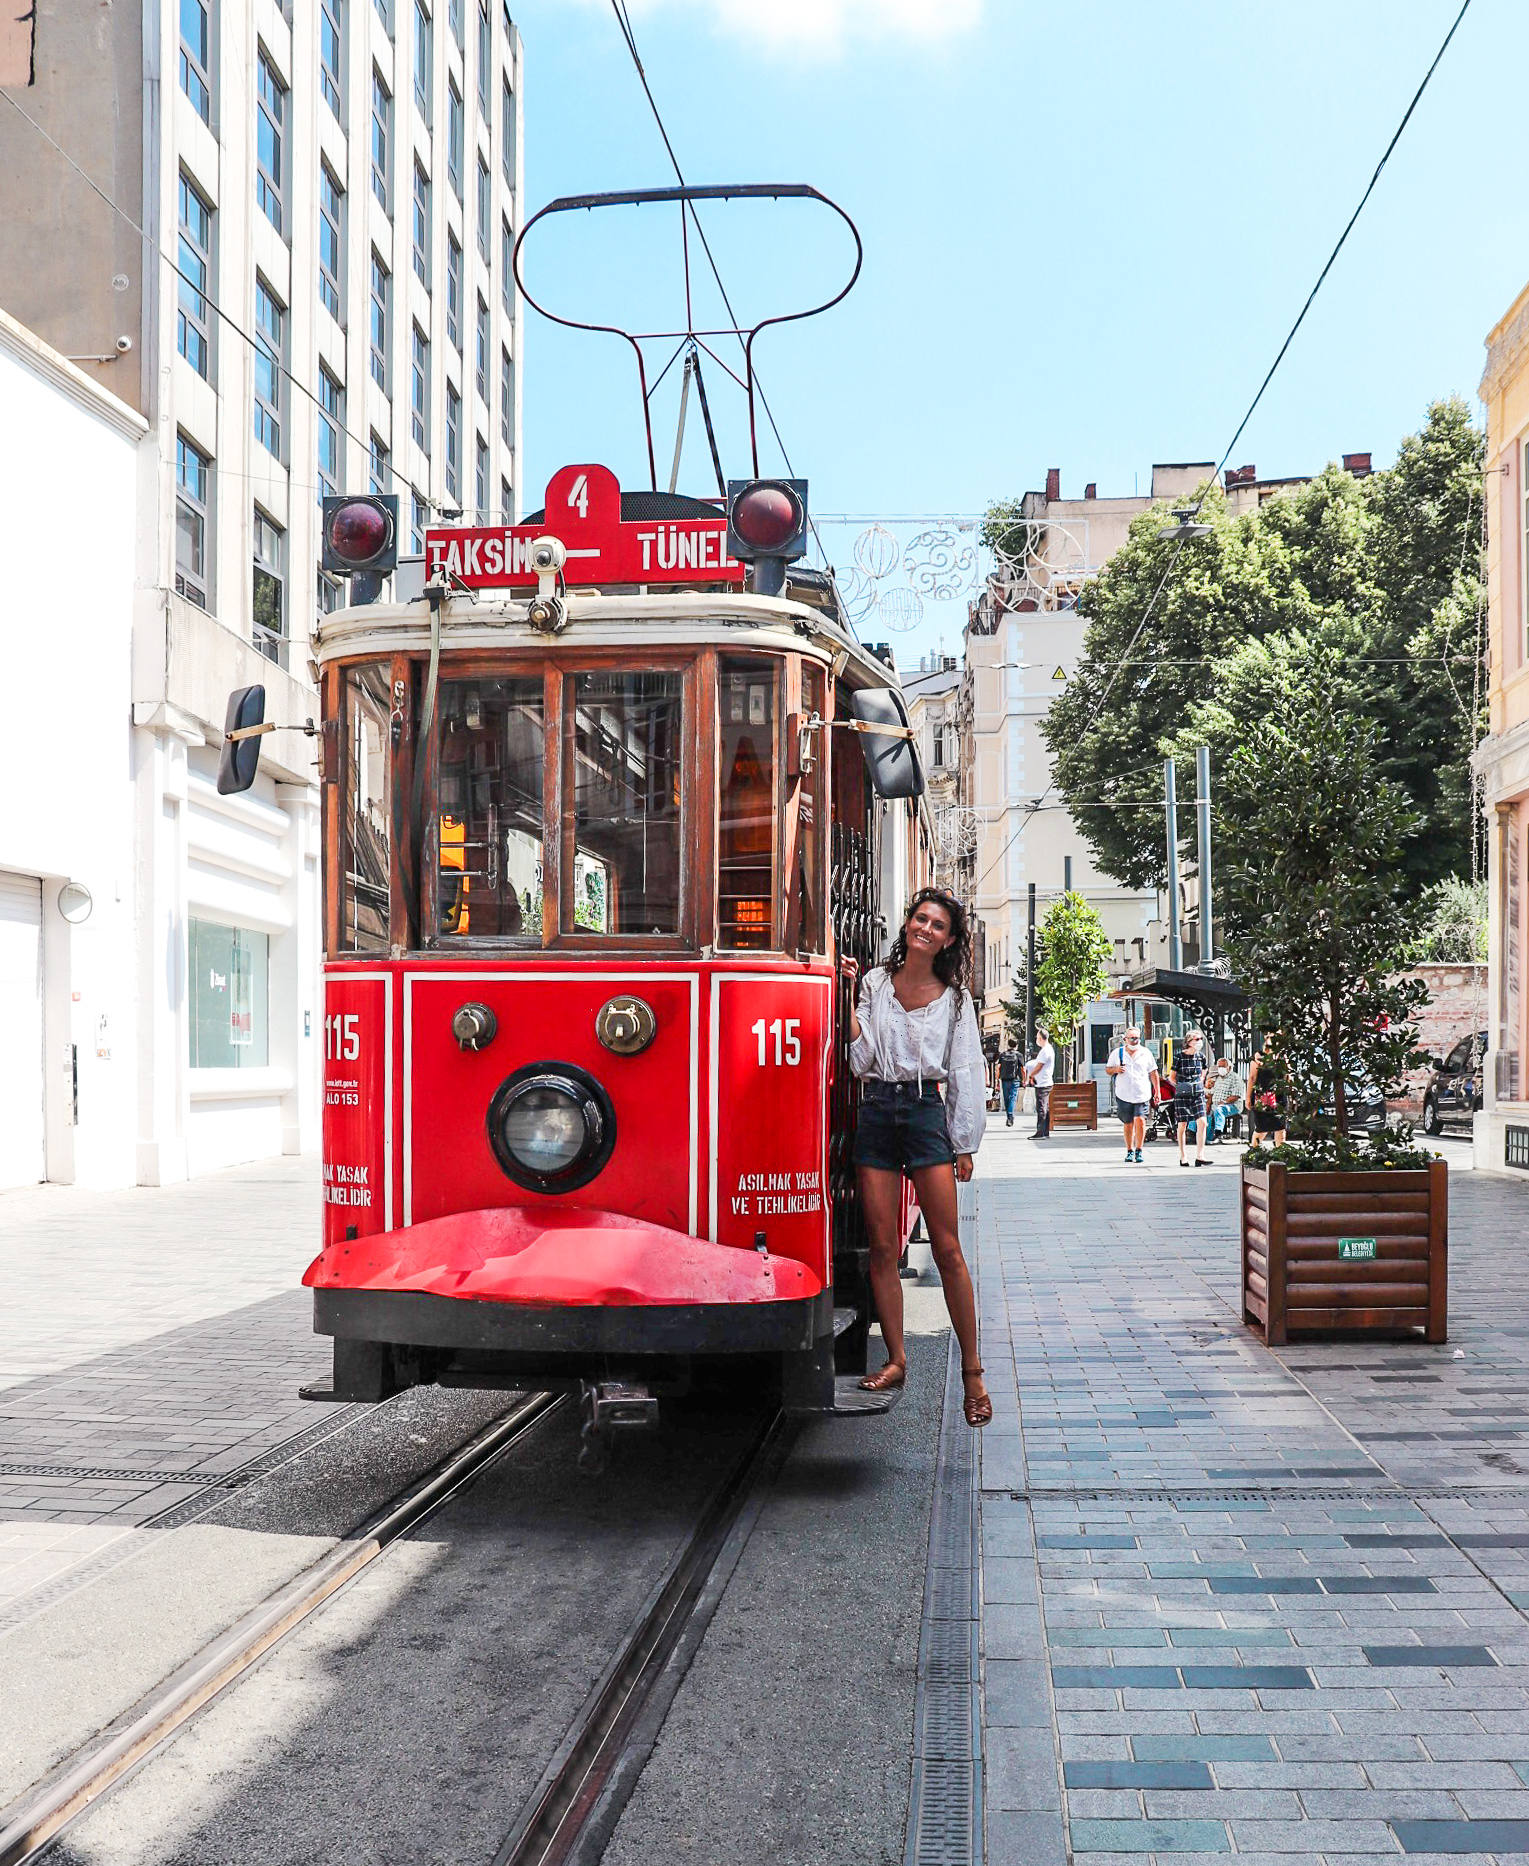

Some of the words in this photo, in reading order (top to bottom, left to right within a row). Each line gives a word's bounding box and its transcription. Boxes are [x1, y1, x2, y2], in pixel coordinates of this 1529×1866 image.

[567, 474, 589, 519] 4
[427, 530, 533, 576] TAKSİM
[636, 525, 739, 570] TÜNEL
[325, 1014, 360, 1061] 115
[751, 1018, 801, 1066] 115
[341, 1093, 359, 1105] 153
[336, 1165, 368, 1184] YASAK
[795, 1171, 820, 1190] YASAK
[731, 1196, 750, 1215] VE
